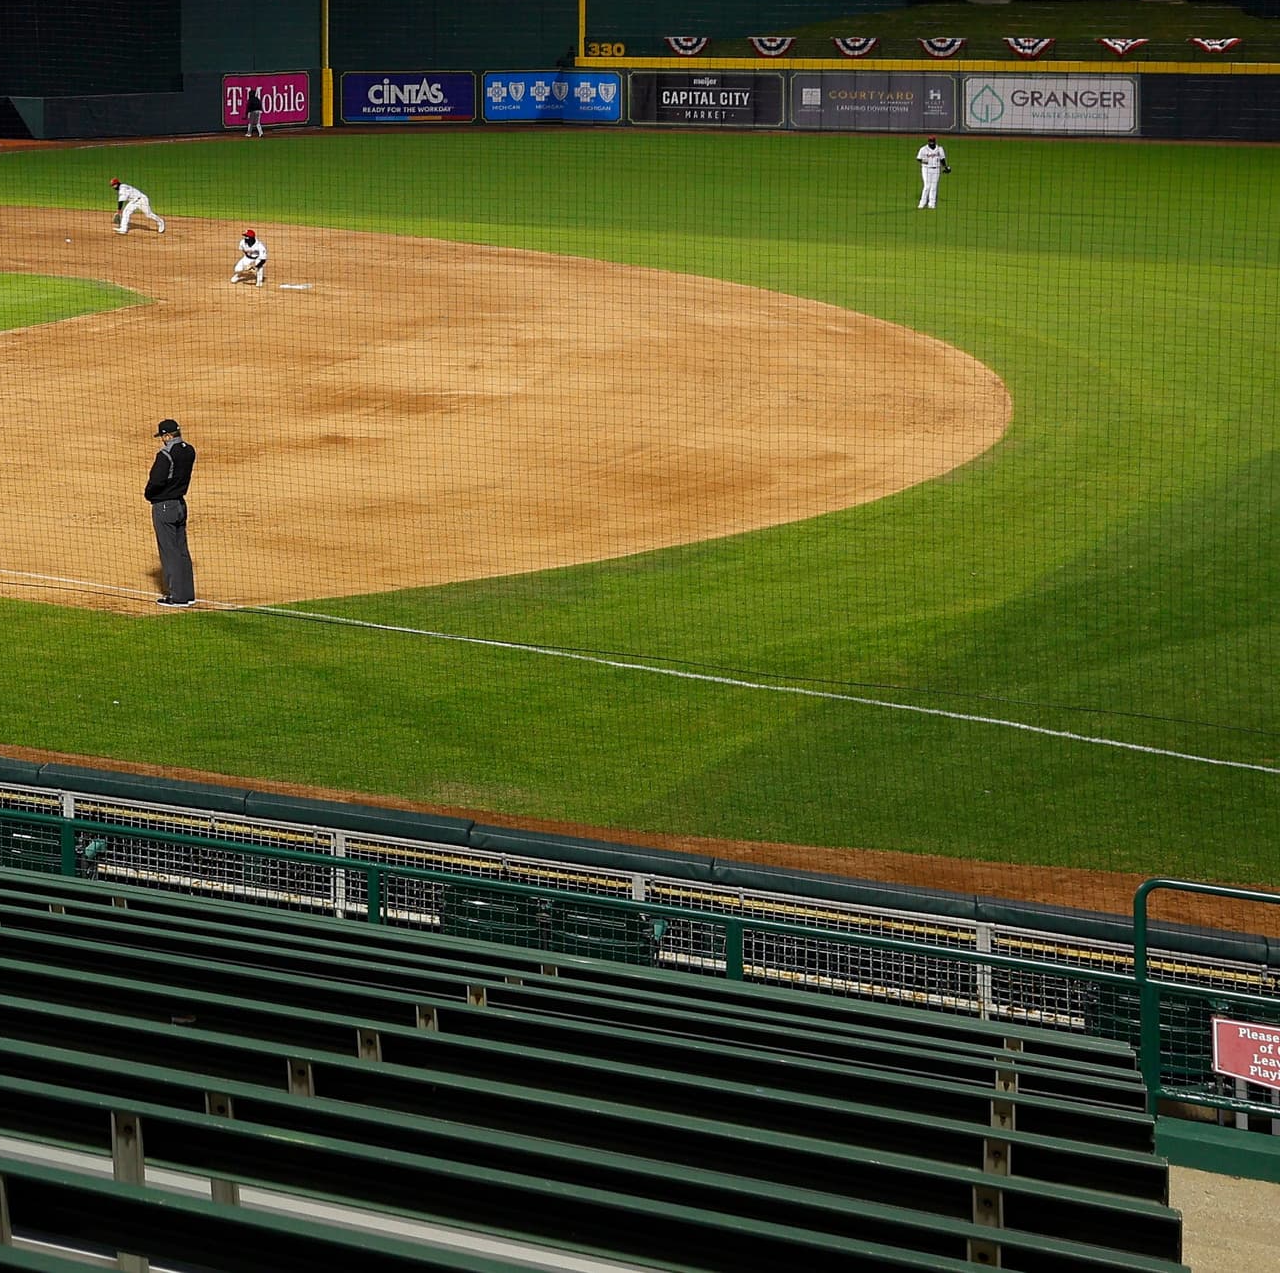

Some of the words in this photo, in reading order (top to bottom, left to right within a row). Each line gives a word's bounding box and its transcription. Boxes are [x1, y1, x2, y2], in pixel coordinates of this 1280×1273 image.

[588, 42, 625, 56] 330
[693, 77, 717, 86] meijer
[662, 91, 716, 105] CAPITAL
[720, 92, 750, 105] CITY
[828, 90, 914, 101] COURTYARD
[1011, 90, 1125, 107] GRANGER
[685, 110, 726, 119] MARKET
[1238, 1027, 1279, 1043] Please
[1259, 1044, 1274, 1054] of
